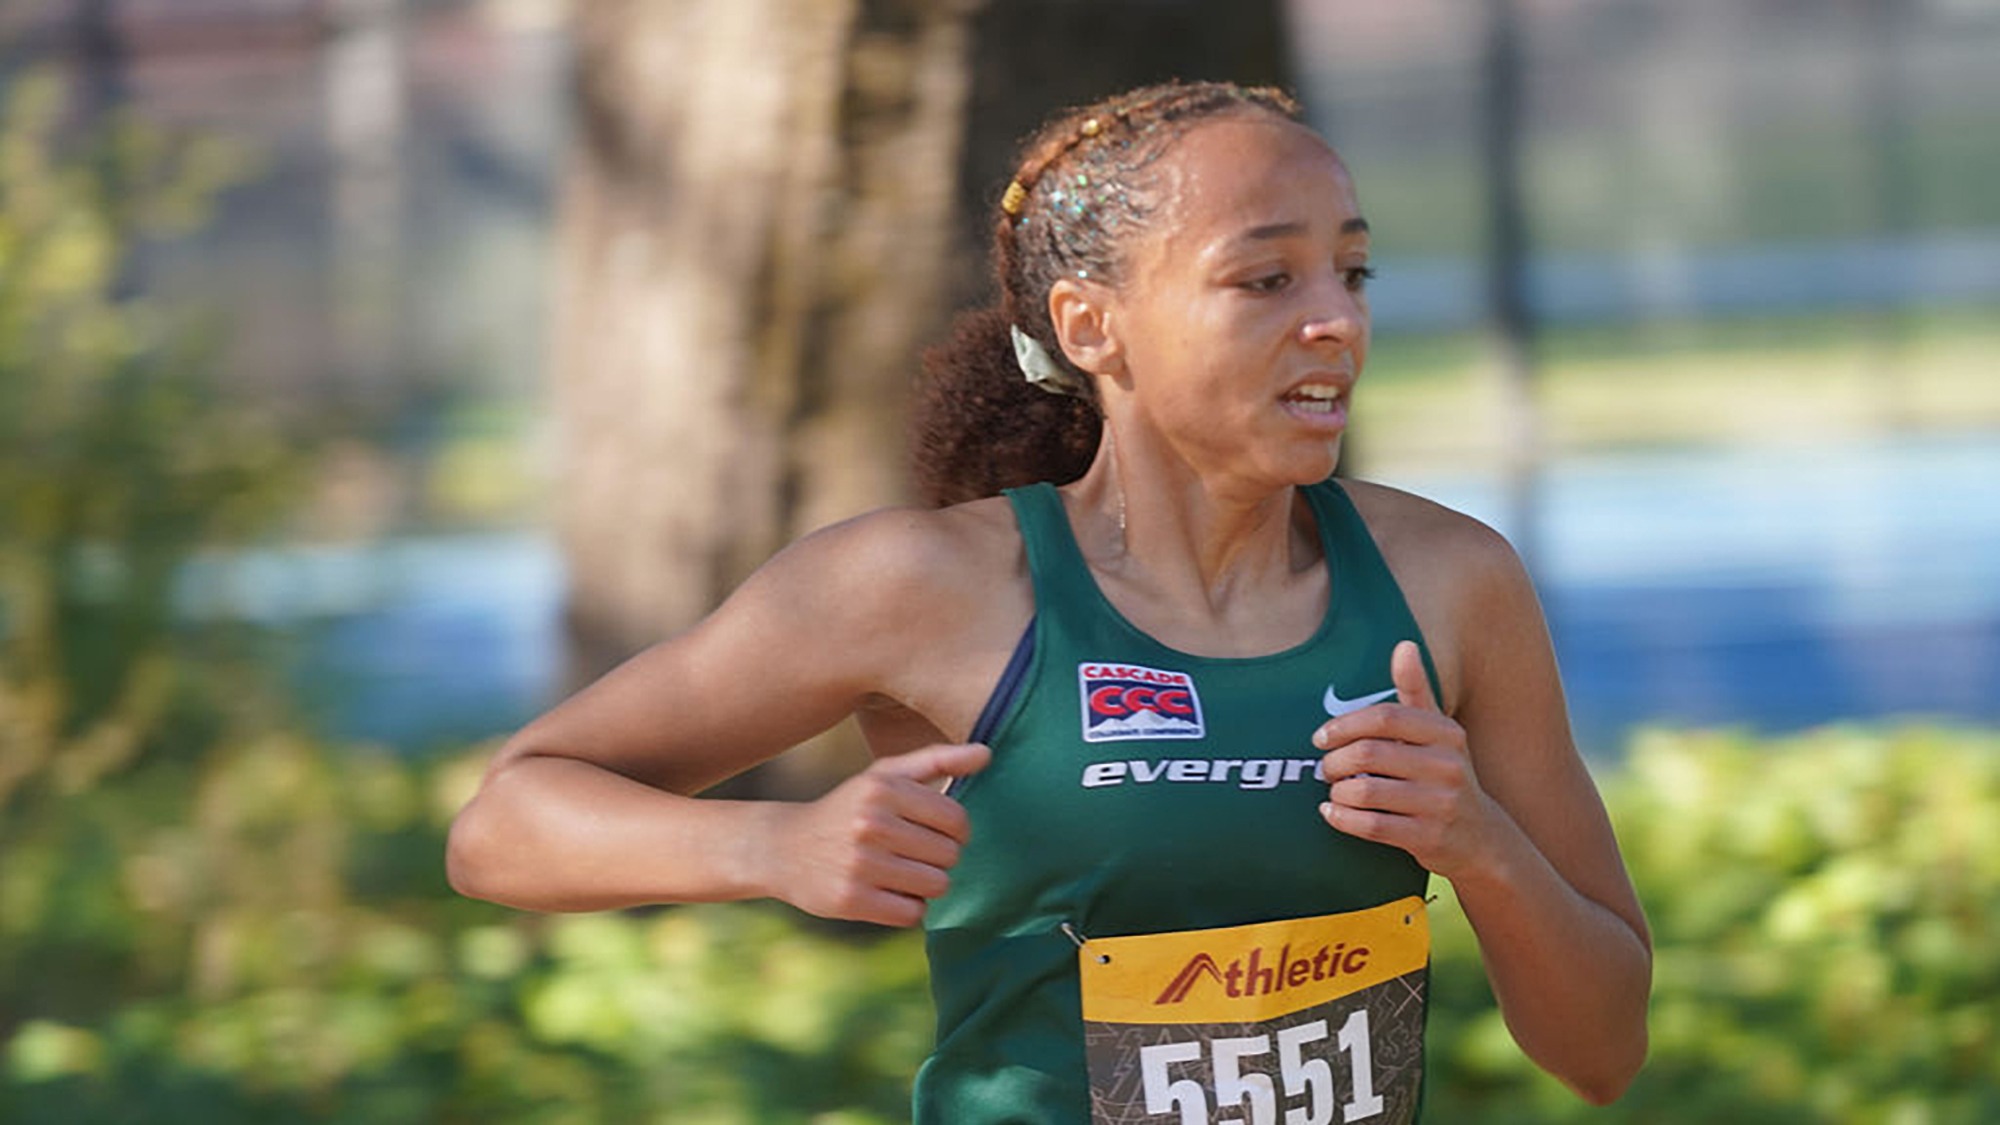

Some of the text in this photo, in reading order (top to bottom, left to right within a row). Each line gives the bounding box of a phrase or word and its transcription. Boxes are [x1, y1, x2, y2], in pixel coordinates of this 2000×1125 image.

[1083, 665, 1187, 685] CASCADE
[1090, 685, 1193, 715] CCC
[1153, 943, 1370, 1005] Athletic
[1140, 1009, 1384, 1125] 5551
